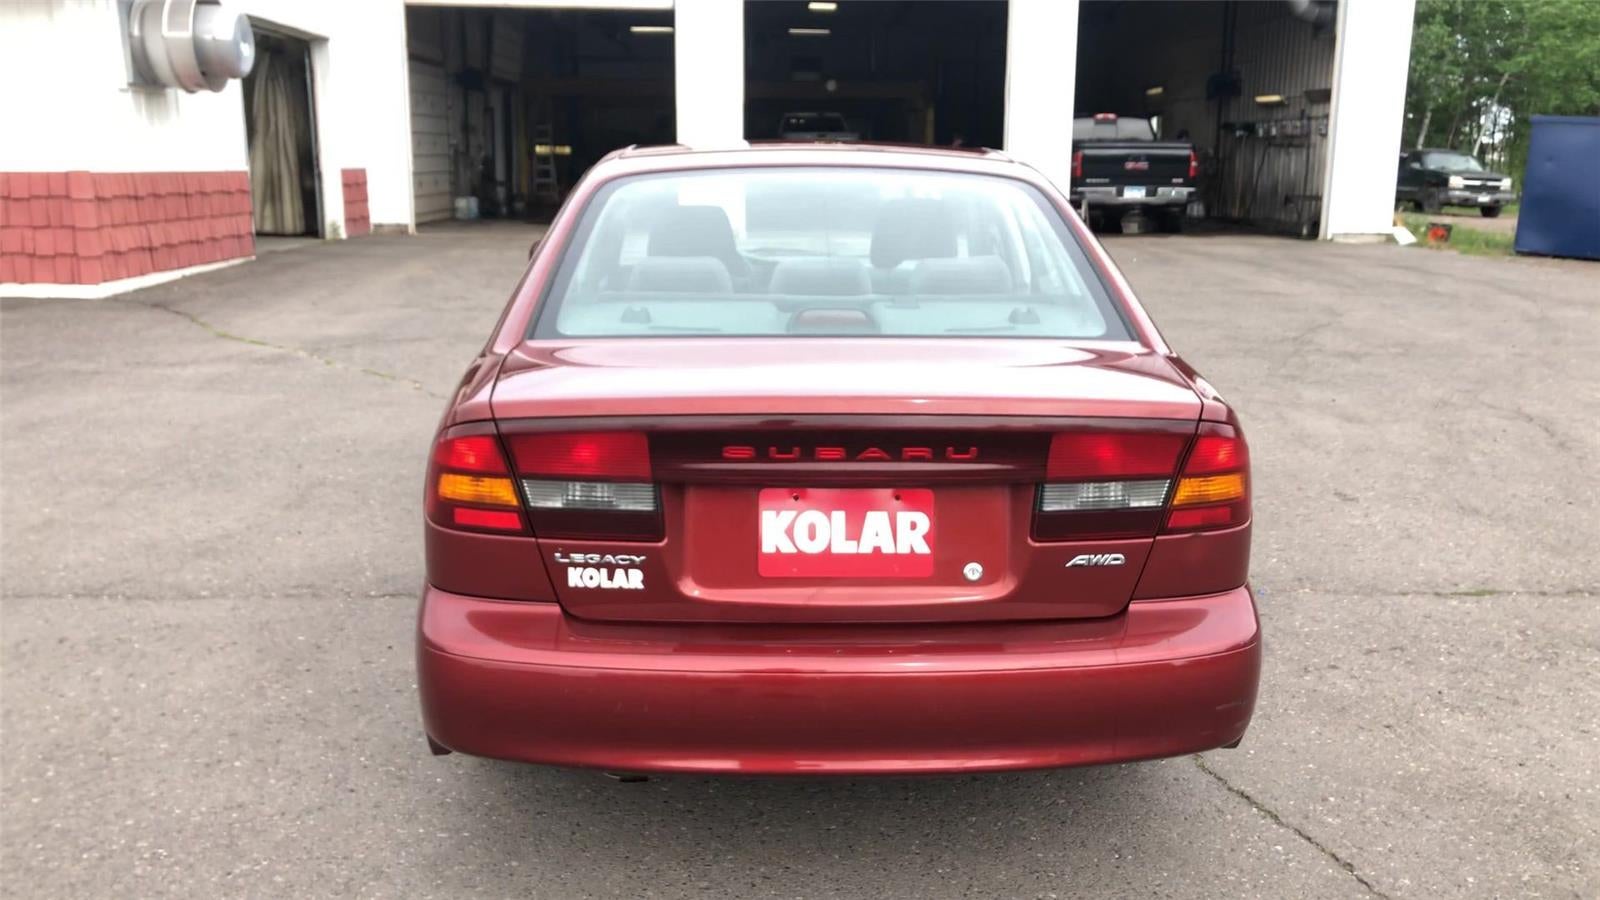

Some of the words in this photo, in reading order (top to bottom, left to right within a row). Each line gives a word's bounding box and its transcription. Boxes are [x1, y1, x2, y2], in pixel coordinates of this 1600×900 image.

[722, 446, 978, 459] SUBARU
[762, 510, 931, 554] KOLAR
[554, 552, 646, 564] LEGACY
[1065, 553, 1125, 567] AWD
[567, 566, 645, 589] KOLAR
